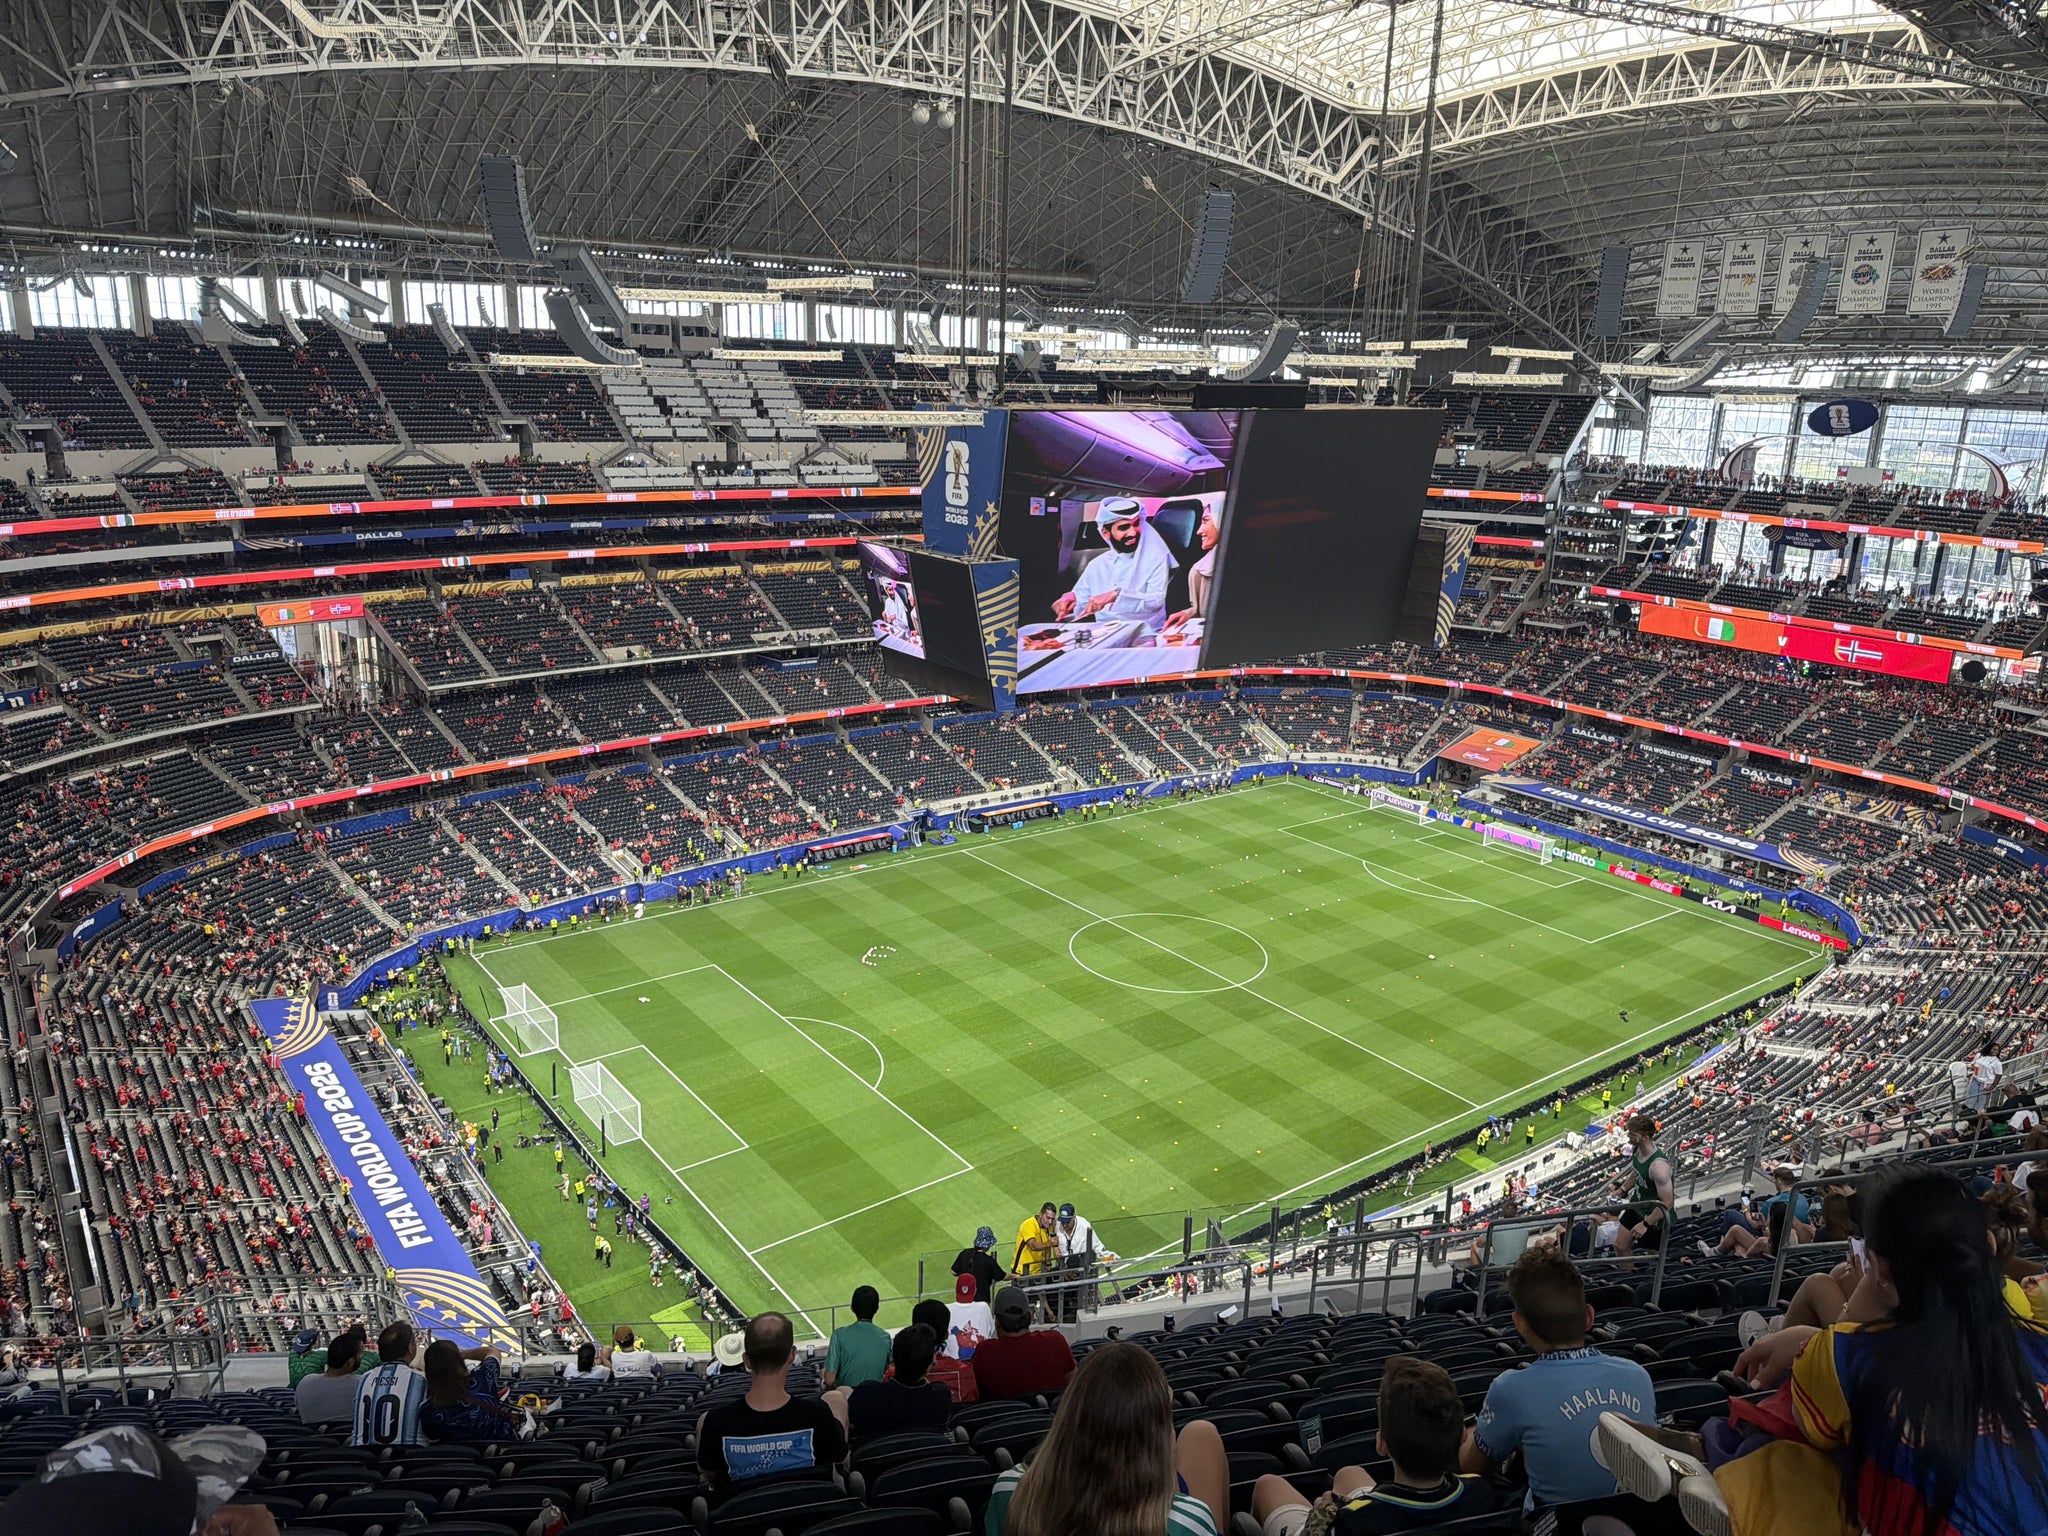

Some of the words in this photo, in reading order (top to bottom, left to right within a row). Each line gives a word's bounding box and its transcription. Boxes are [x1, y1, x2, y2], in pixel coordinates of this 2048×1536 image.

[1929, 246, 1956, 254] DALLAS
[952, 492, 962, 500] FIFA
[945, 506, 959, 514] WORLD
[945, 513, 968, 525] 2026
[356, 531, 402, 541] DALLAS
[233, 652, 279, 663] DALLAS
[1572, 728, 1616, 743] DALLAS
[1639, 743, 1653, 752] FIFA
[1654, 746, 1677, 758] WORLD
[1676, 751, 1690, 761] CUP
[1690, 755, 1712, 767] 2026
[1740, 767, 1793, 786] DALLAS
[1364, 789, 1386, 802] QATAR
[1387, 794, 1415, 811] AIRWAYS
[1436, 809, 1454, 824] VISA
[1491, 808, 1502, 816] FIFA
[1541, 787, 1579, 801] FIFA
[1581, 798, 1646, 819] WORLD
[1647, 816, 1688, 830] CUP
[1685, 828, 1759, 851] 2026
[1553, 847, 1596, 867] aramco
[1729, 878, 1745, 888] FIFA
[1783, 922, 1821, 943] Lenovo
[304, 1062, 354, 1113] 2026
[331, 1112, 373, 1144] CUP
[350, 1142, 409, 1207] WORLD
[385, 1201, 434, 1249] FIFA
[371, 1376, 399, 1388] MESSI
[1559, 1387, 1641, 1421] HAALAND
[362, 1393, 401, 1445] 10
[730, 1443, 746, 1454] FIFA
[746, 1441, 776, 1454] WORLD
[776, 1440, 793, 1450] CUP
